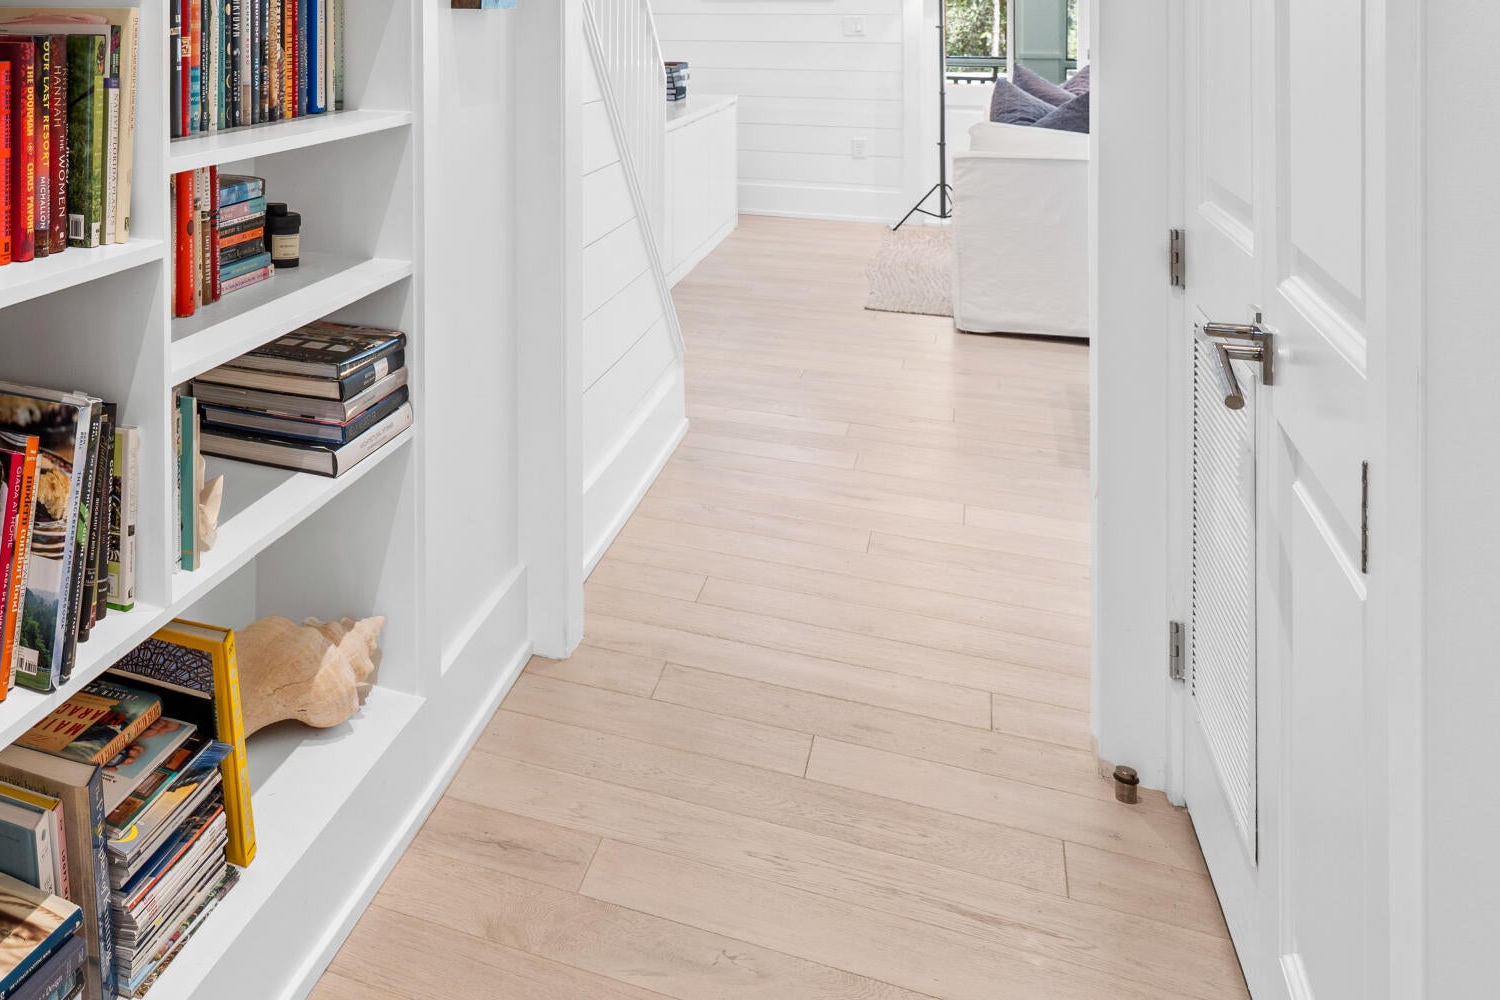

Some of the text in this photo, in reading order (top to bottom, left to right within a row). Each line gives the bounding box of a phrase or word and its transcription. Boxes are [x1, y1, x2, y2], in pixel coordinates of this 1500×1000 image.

[42, 115, 50, 168] RESORT
[54, 66, 62, 128] HANNAH
[58, 154, 67, 217] WOMEN
[13, 466, 23, 498] GIADA
[84, 467, 94, 516] FOOTHILLS
[6, 516, 16, 549] HOME
[68, 487, 80, 546] BLACKBERRY
[11, 475, 34, 613] modern comfort food
[60, 576, 71, 630] COOKBOOK
